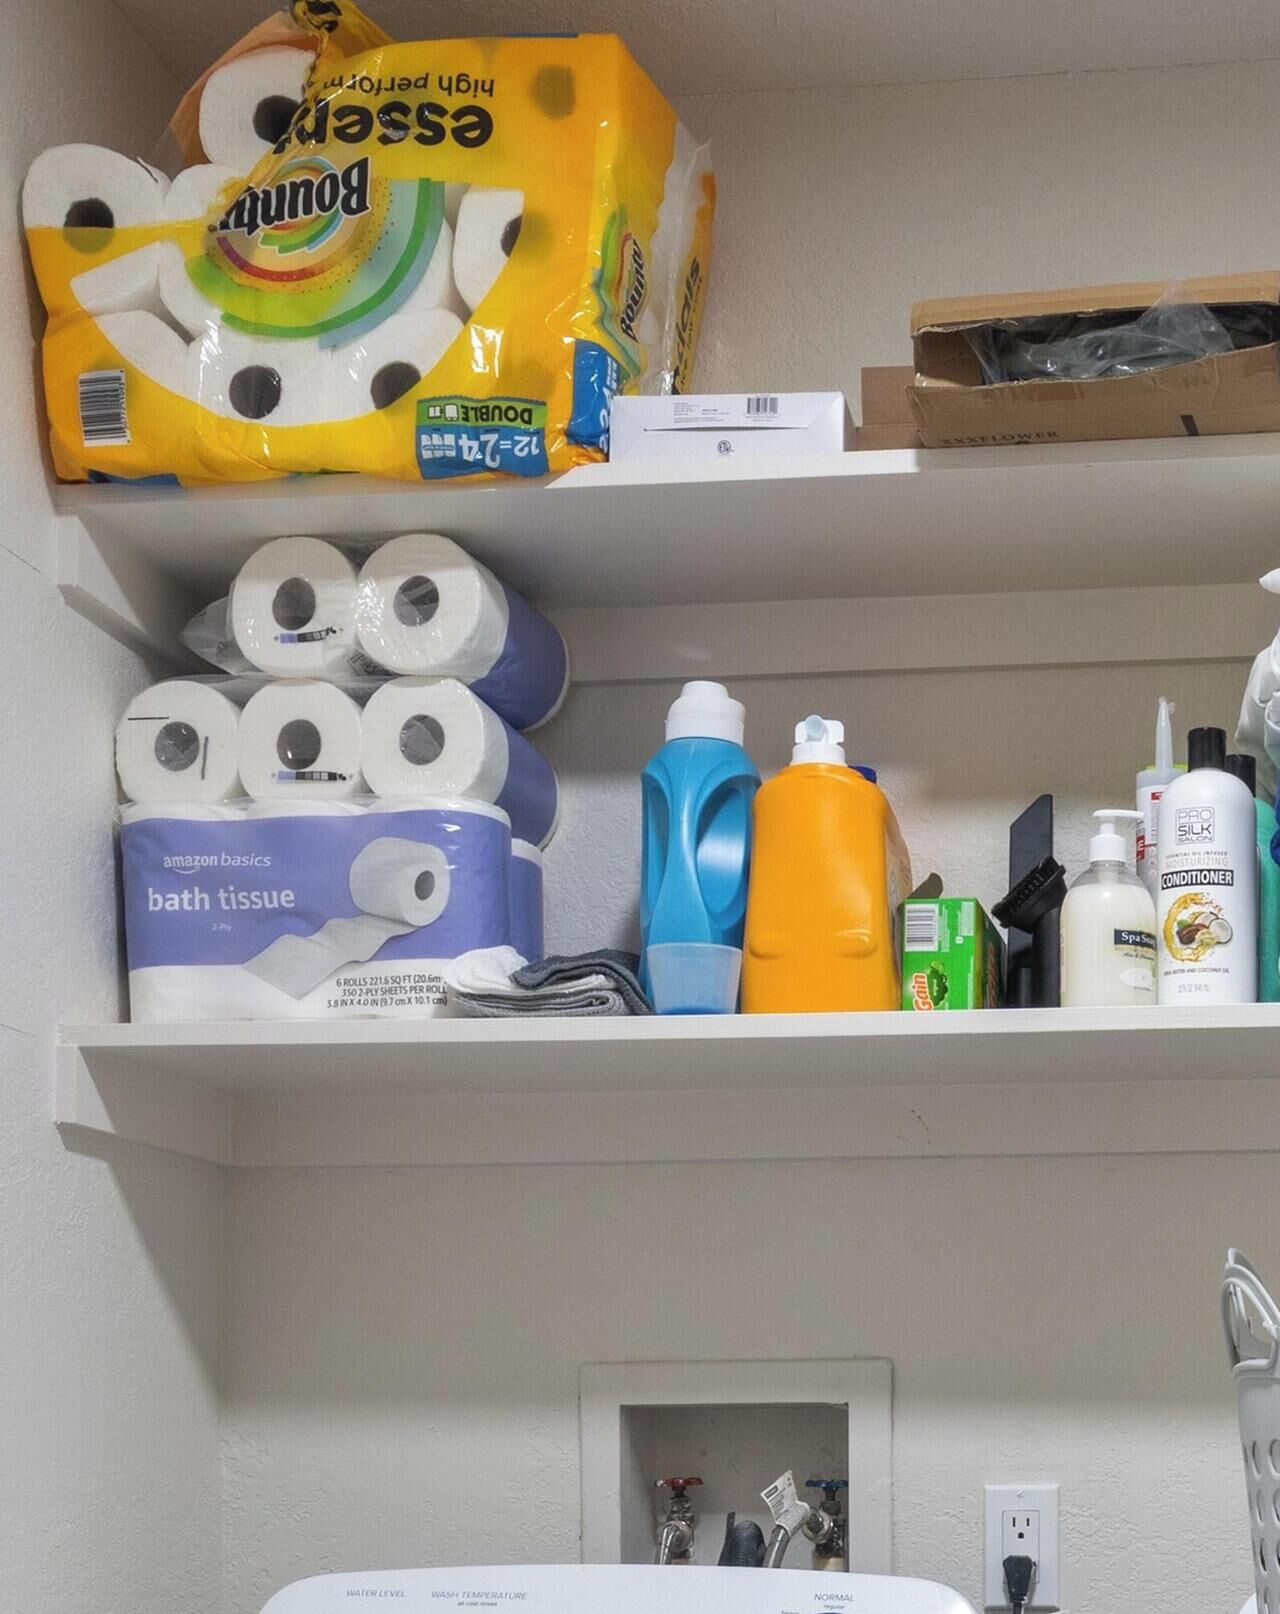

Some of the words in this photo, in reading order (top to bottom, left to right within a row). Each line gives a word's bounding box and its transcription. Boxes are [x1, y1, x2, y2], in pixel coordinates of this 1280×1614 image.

[438, 73, 495, 98] high
[461, 404, 533, 426] DOUBLE
[1178, 809, 1212, 821] PRO
[1178, 824, 1212, 836] SILK
[163, 855, 218, 868] amazon
[220, 852, 271, 867] basics
[1162, 870, 1233, 888] CONDITIONER
[148, 886, 210, 912] bath
[217, 885, 295, 911] tissue
[1121, 931, 1140, 943] Spa
[336, 979, 342, 987] 6
[343, 978, 368, 987] ROLLS
[390, 976, 400, 985] SQ
[403, 975, 412, 984] FT
[342, 989, 357, 997] 350
[358, 988, 379, 997] 2-PLY
[380, 986, 408, 996] SHEETS
[409, 985, 424, 994] PER
[426, 985, 447, 995] ROLL
[912, 972, 934, 1011] Gain
[378, 1590, 406, 1598] LEVEL
[461, 1591, 528, 1600] TEMPERATURE
[814, 1593, 854, 1601] NORMAL
